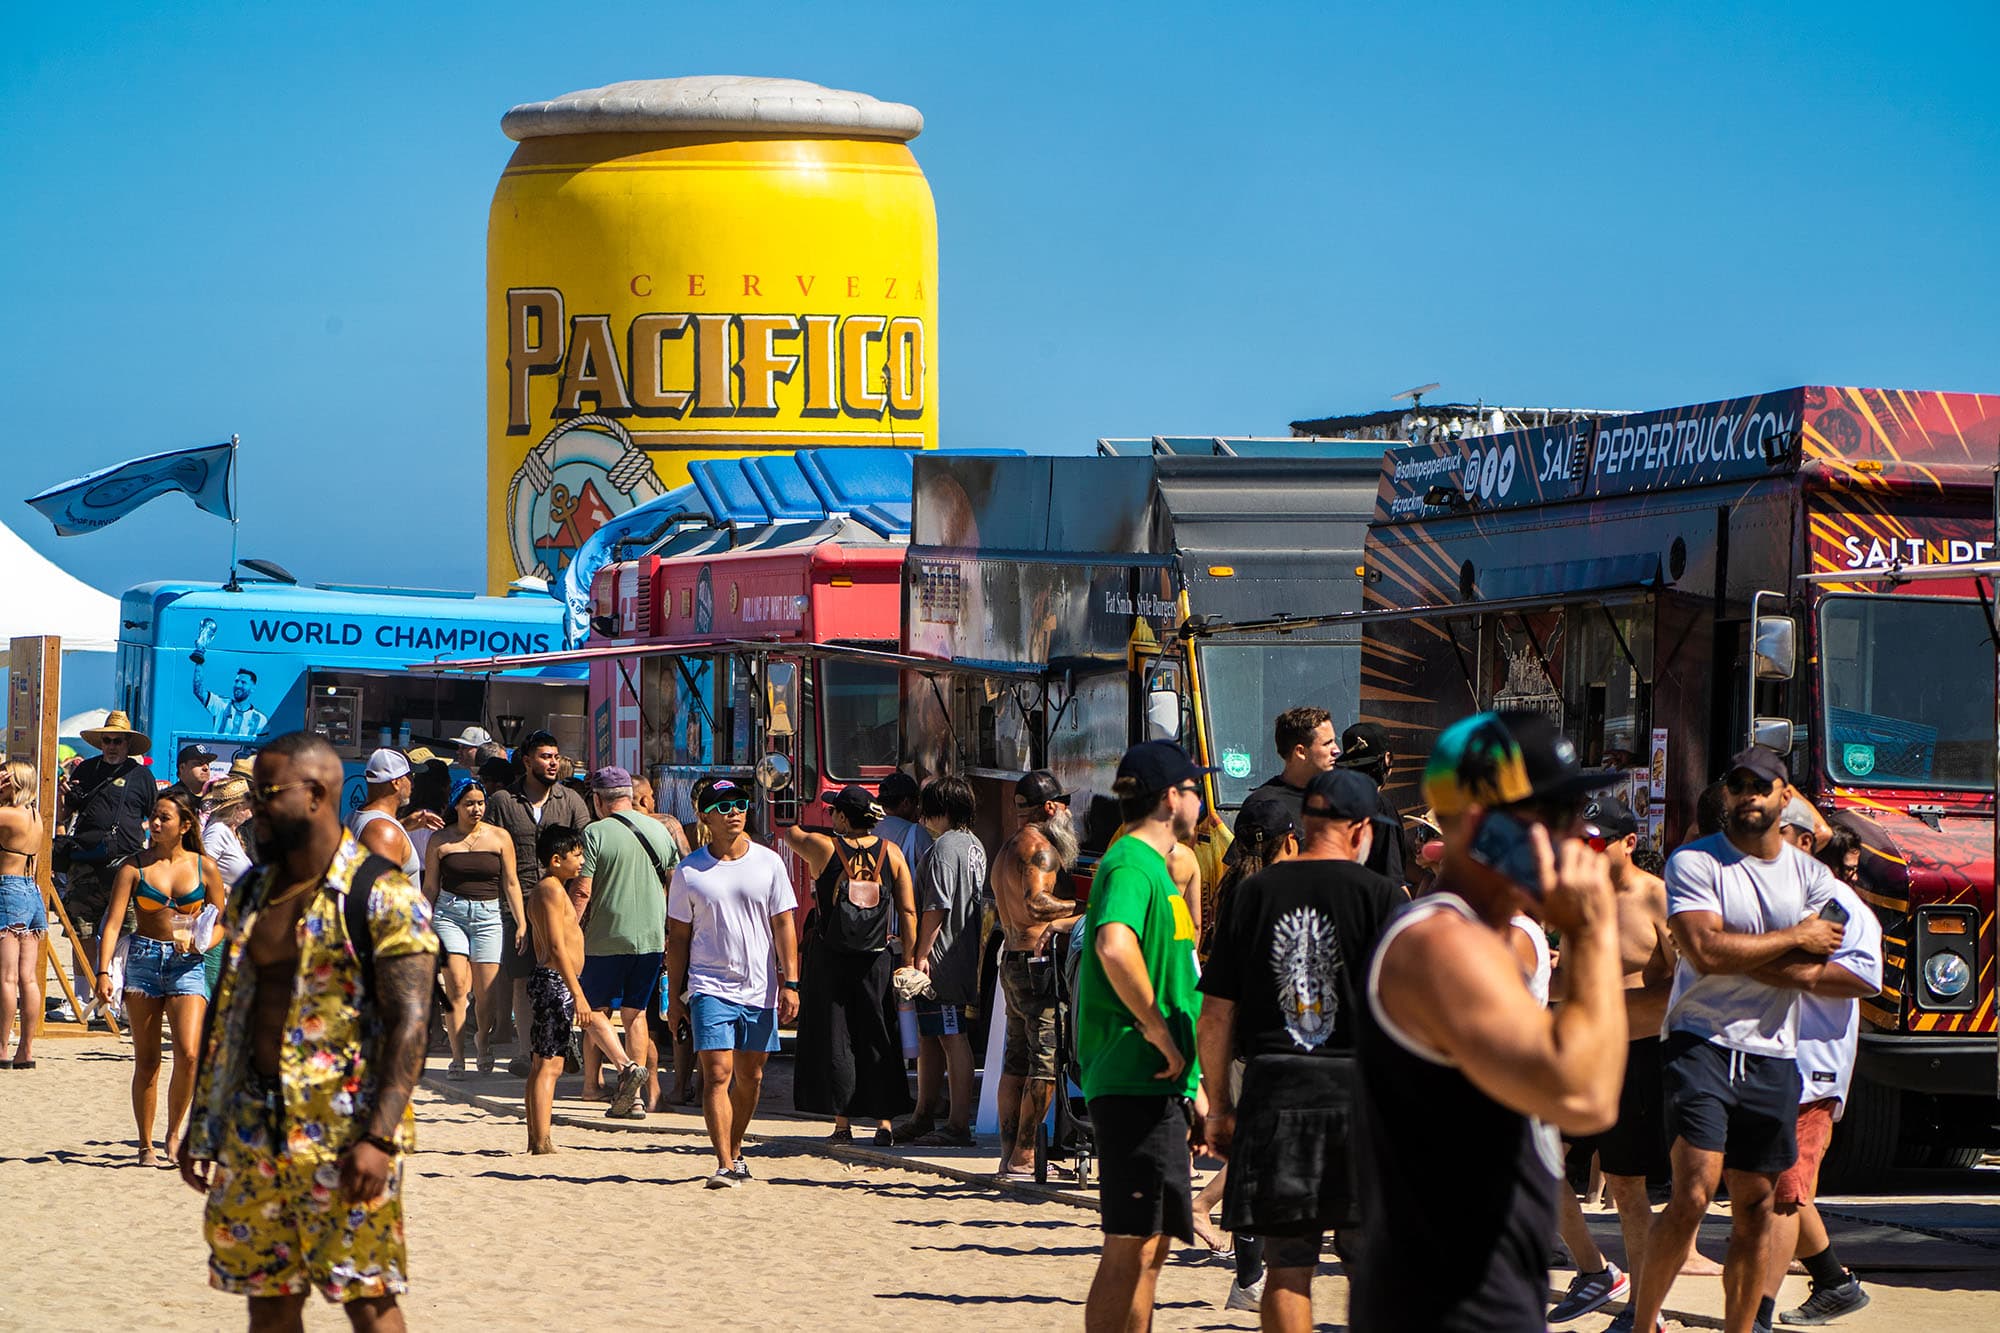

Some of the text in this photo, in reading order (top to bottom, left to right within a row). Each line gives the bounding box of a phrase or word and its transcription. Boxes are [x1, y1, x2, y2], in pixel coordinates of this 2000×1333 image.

[630, 274, 924, 300] CERVEZA
[506, 287, 926, 436] PACIFICO
[1152, 594, 1177, 624] Burgers
[250, 619, 550, 655] WORLD CHAMPIONS
